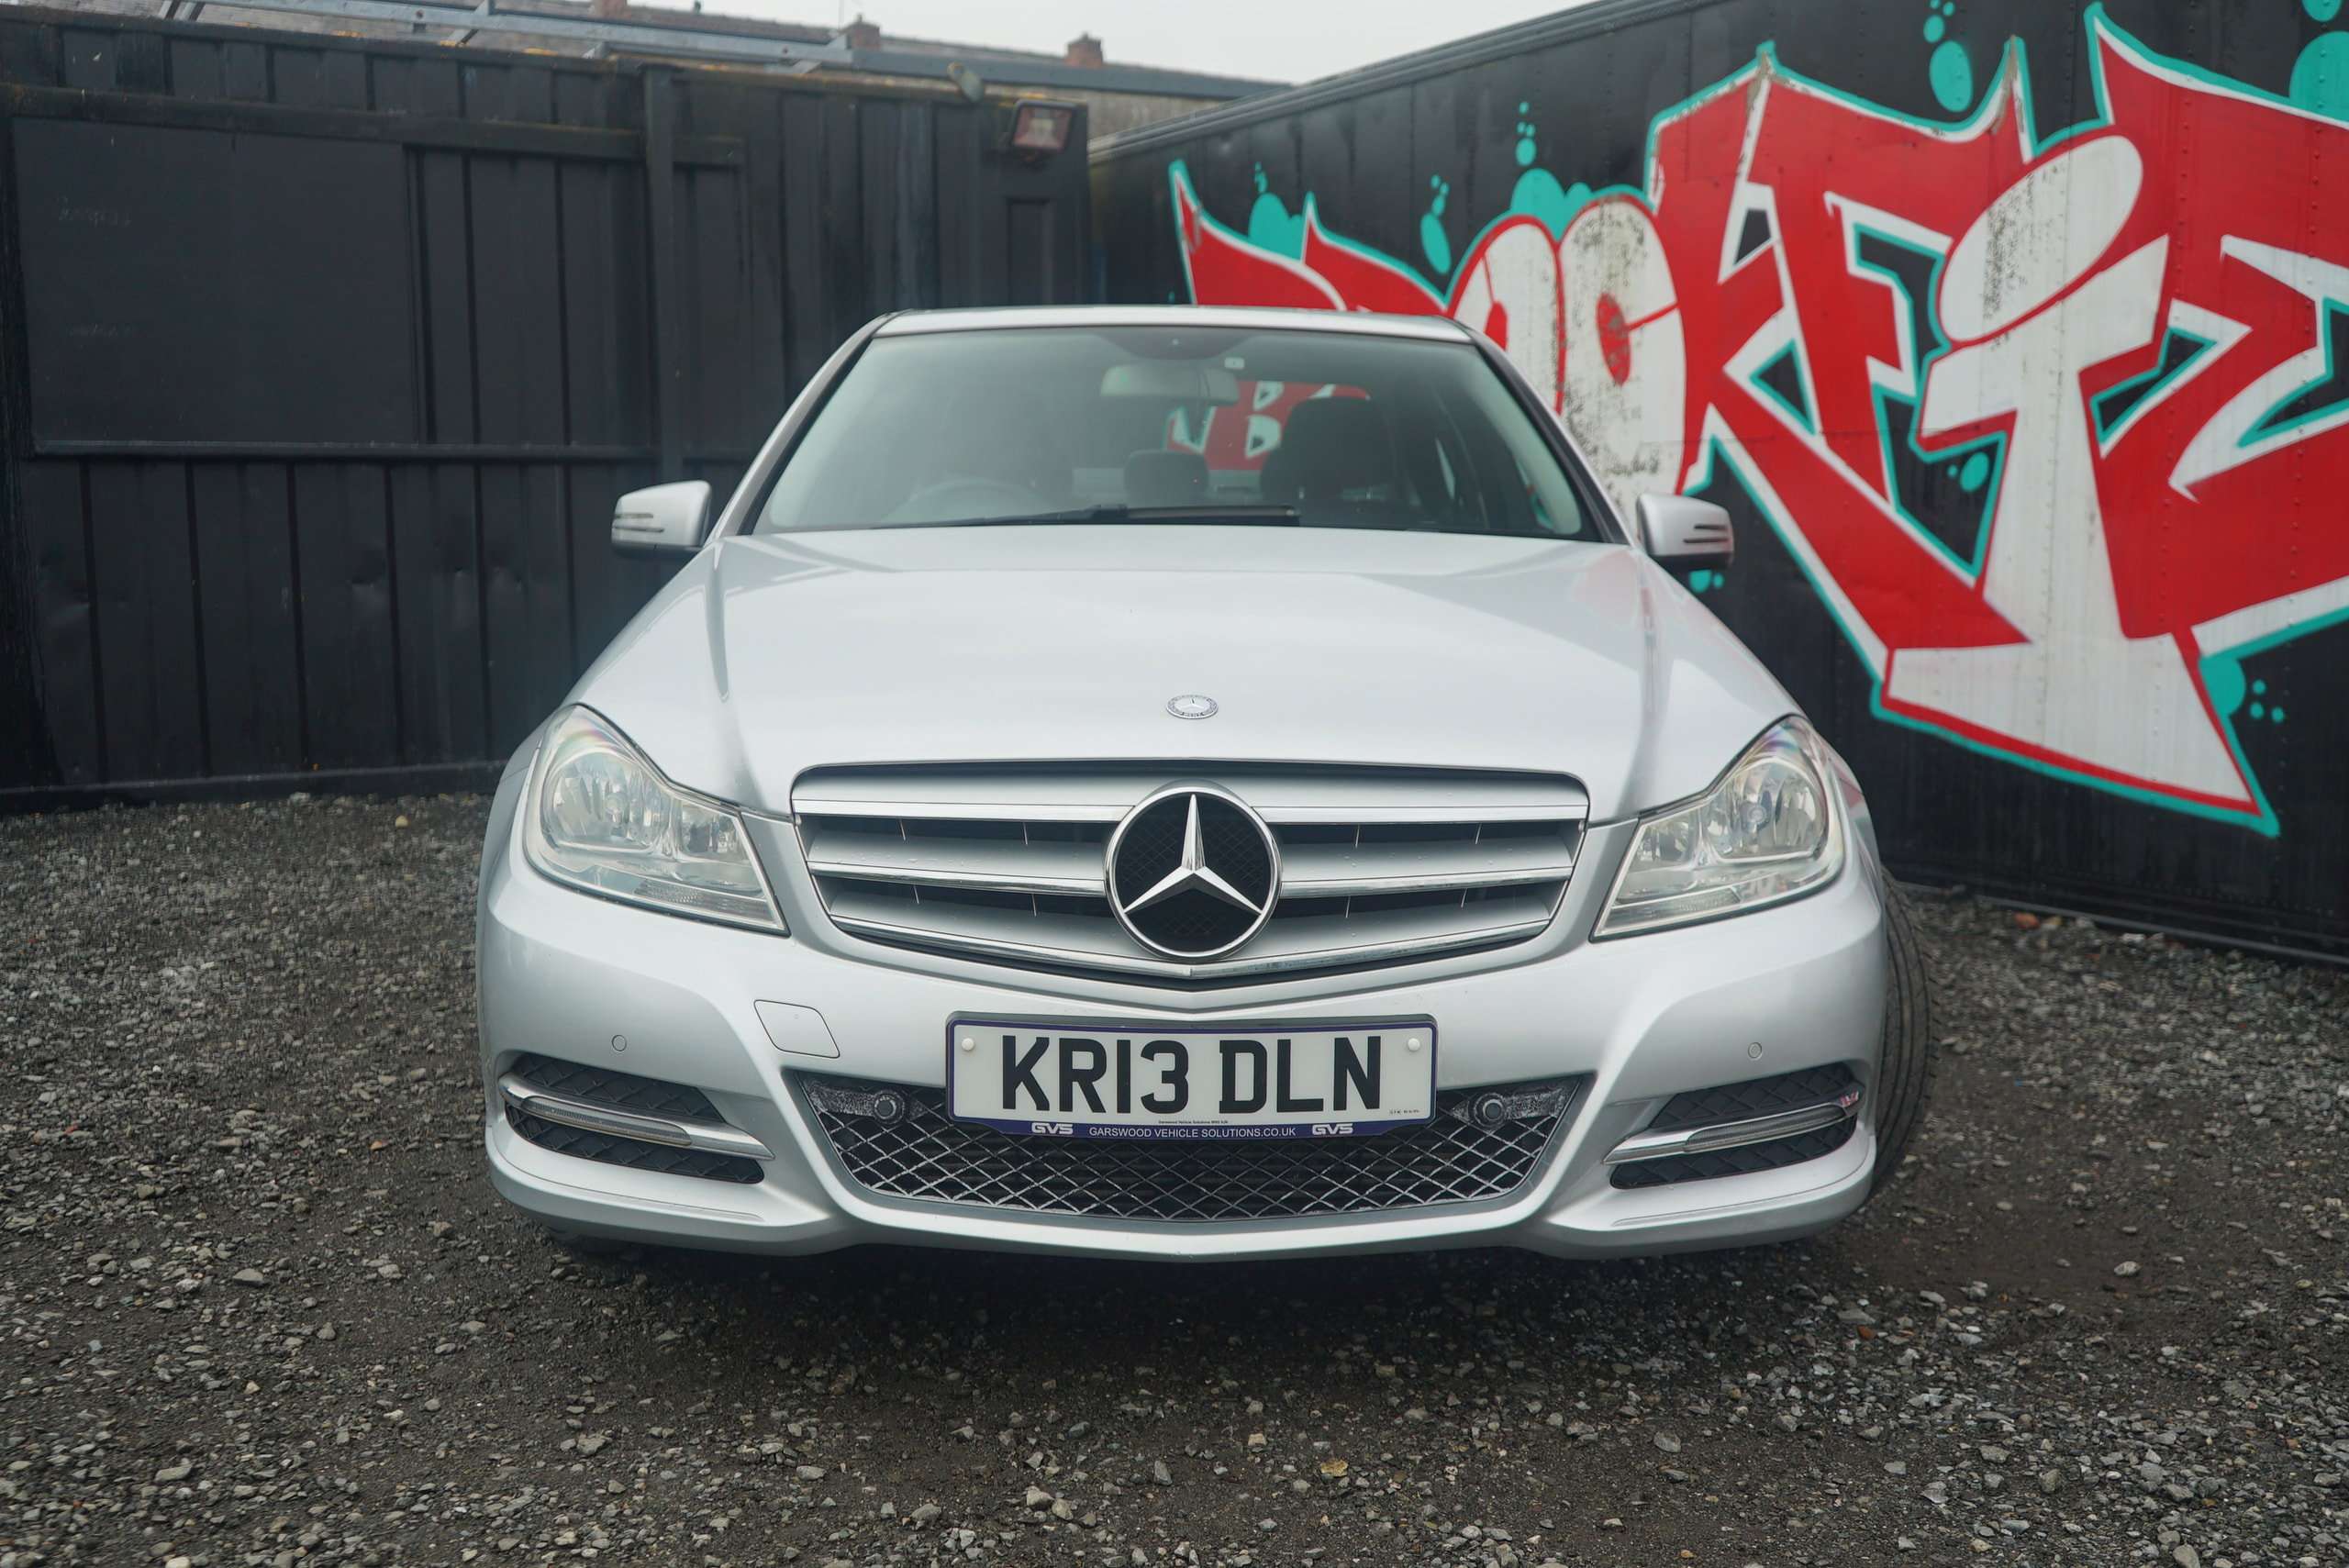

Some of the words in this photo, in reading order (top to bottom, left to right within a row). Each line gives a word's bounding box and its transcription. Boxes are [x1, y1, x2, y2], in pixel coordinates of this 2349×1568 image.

[1002, 1035, 1189, 1114] KR13
[1219, 1036, 1381, 1114] DLN
[1031, 1122, 1074, 1135] GVS
[1089, 1127, 1152, 1138] GARSWOOD
[1153, 1129, 1198, 1138] VEHICLE
[1201, 1127, 1297, 1138] SOLUTIONS.CO.UK
[1311, 1122, 1353, 1136] GVS
